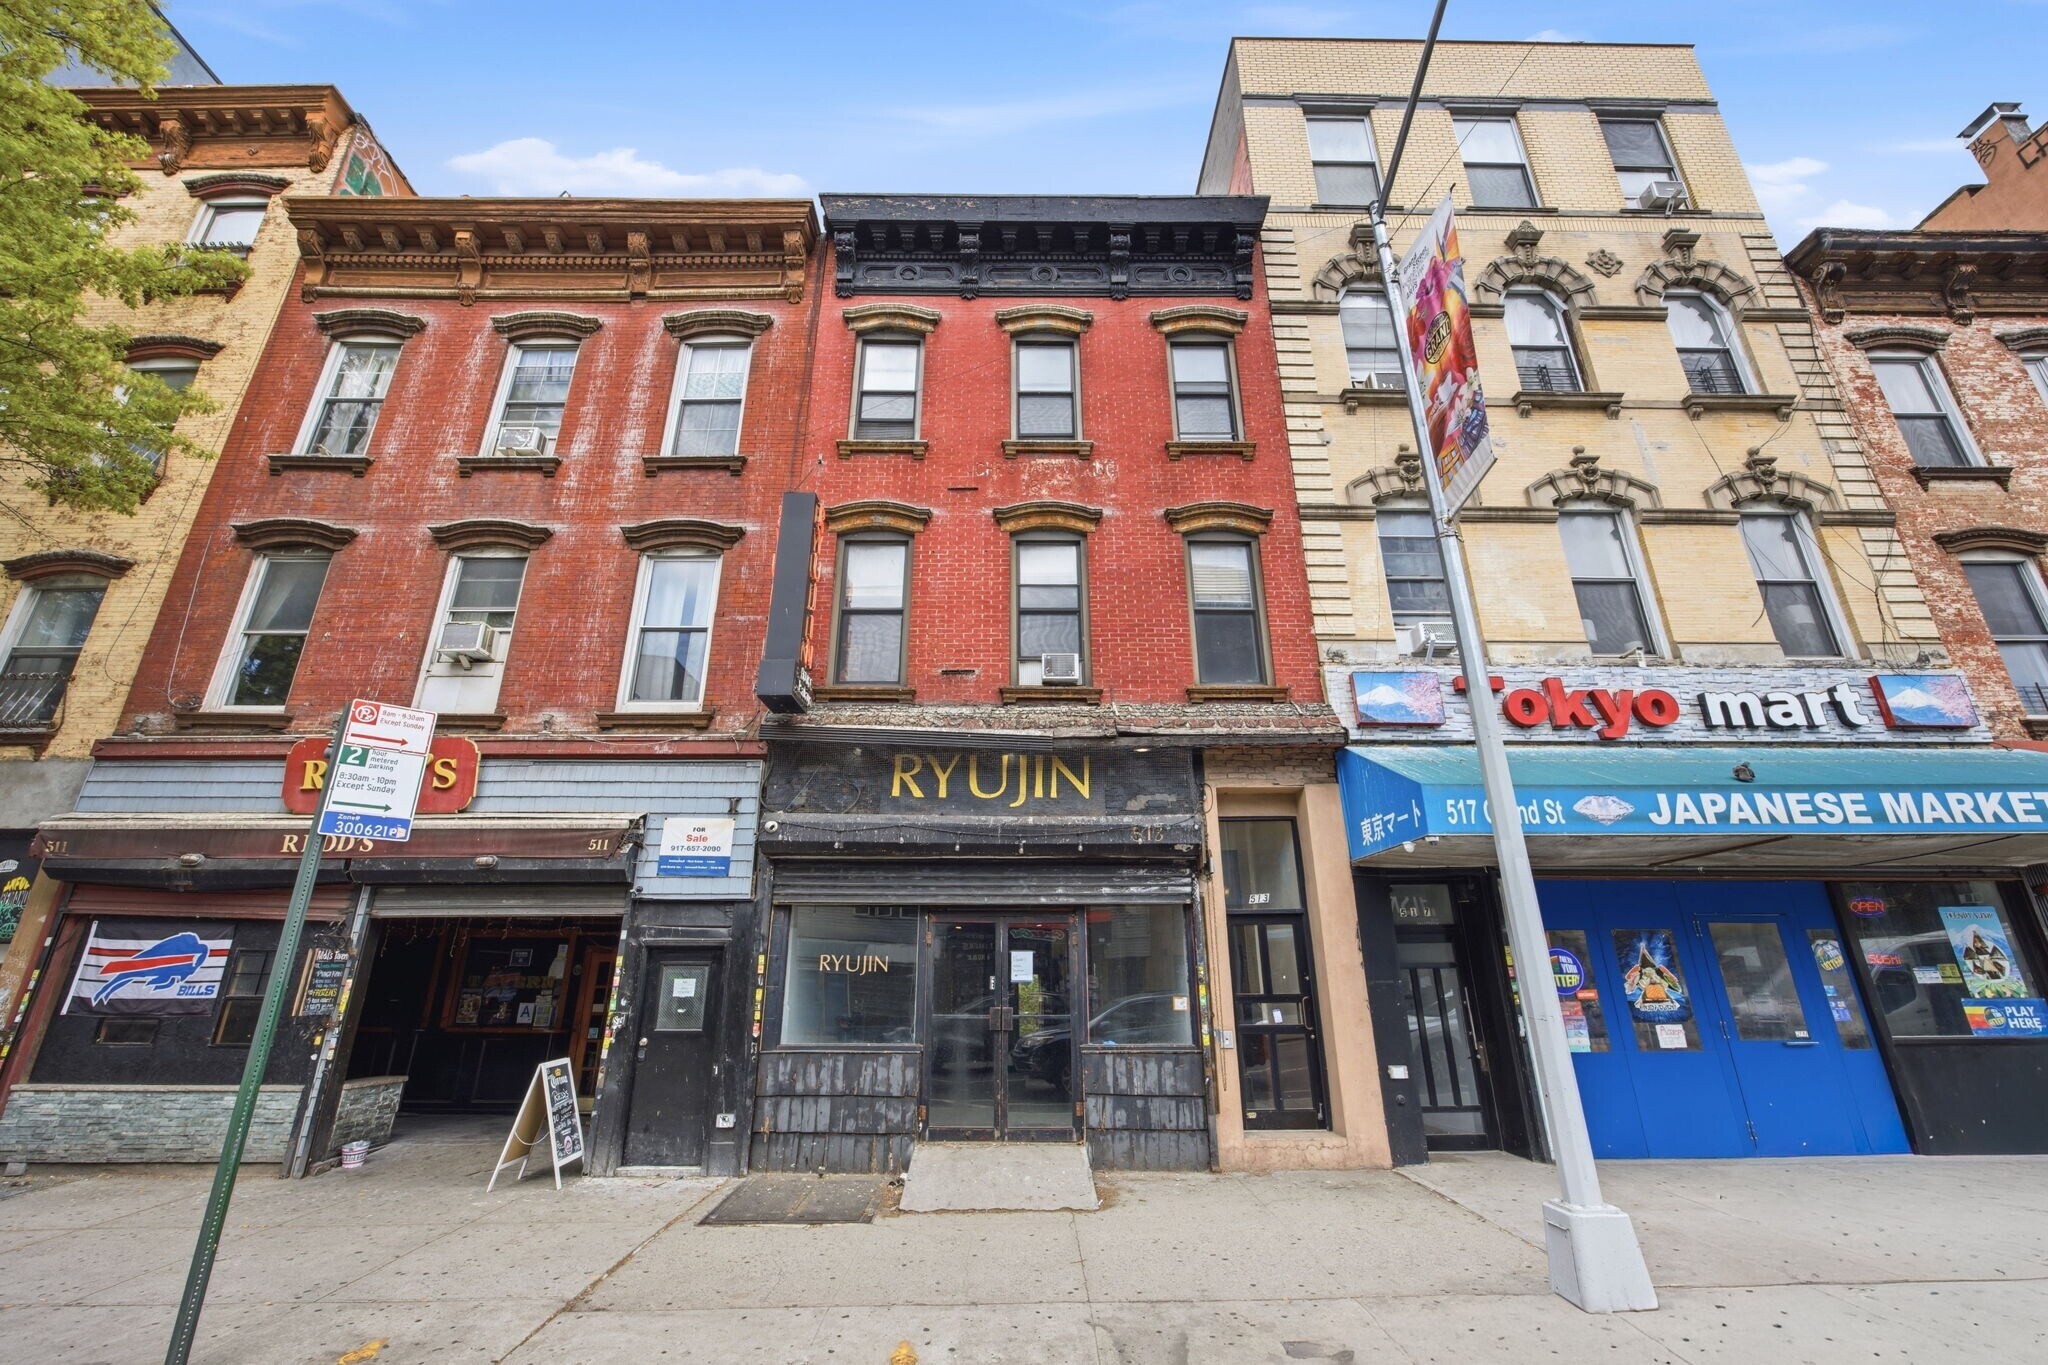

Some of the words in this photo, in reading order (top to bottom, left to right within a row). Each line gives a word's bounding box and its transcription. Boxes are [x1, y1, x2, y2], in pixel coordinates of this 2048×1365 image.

[1697, 682, 1870, 728] mart
[380, 718, 401, 727] Except
[402, 720, 425, 731] Sunday
[346, 747, 362, 764] 2
[370, 756, 399, 765] metered
[368, 764, 394, 772] parking
[339, 772, 370, 782] 8:30am
[377, 777, 397, 785] 10pm
[890, 753, 1090, 808] RYUJIN
[336, 780, 364, 791] Except
[366, 784, 396, 794] Sunday
[1446, 799, 1476, 825] 517
[1543, 799, 1566, 825] St
[1649, 792, 1873, 825] JAPANESE
[334, 821, 388, 837] 300621
[1361, 800, 1421, 846] 東京マート
[280, 834, 374, 853] RDD'S
[686, 834, 708, 843] Sale
[46, 841, 68, 853] 511
[588, 839, 608, 851] 511
[1250, 894, 1269, 903] 513
[1400, 907, 1431, 917] 517
[1850, 902, 1884, 912] OPEN
[819, 954, 889, 976] RYUJIN
[177, 985, 215, 996] BILLS
[520, 1007, 530, 1018] A
[2004, 1006, 2034, 1017] PLAY
[2008, 1017, 2042, 1028] HERE
